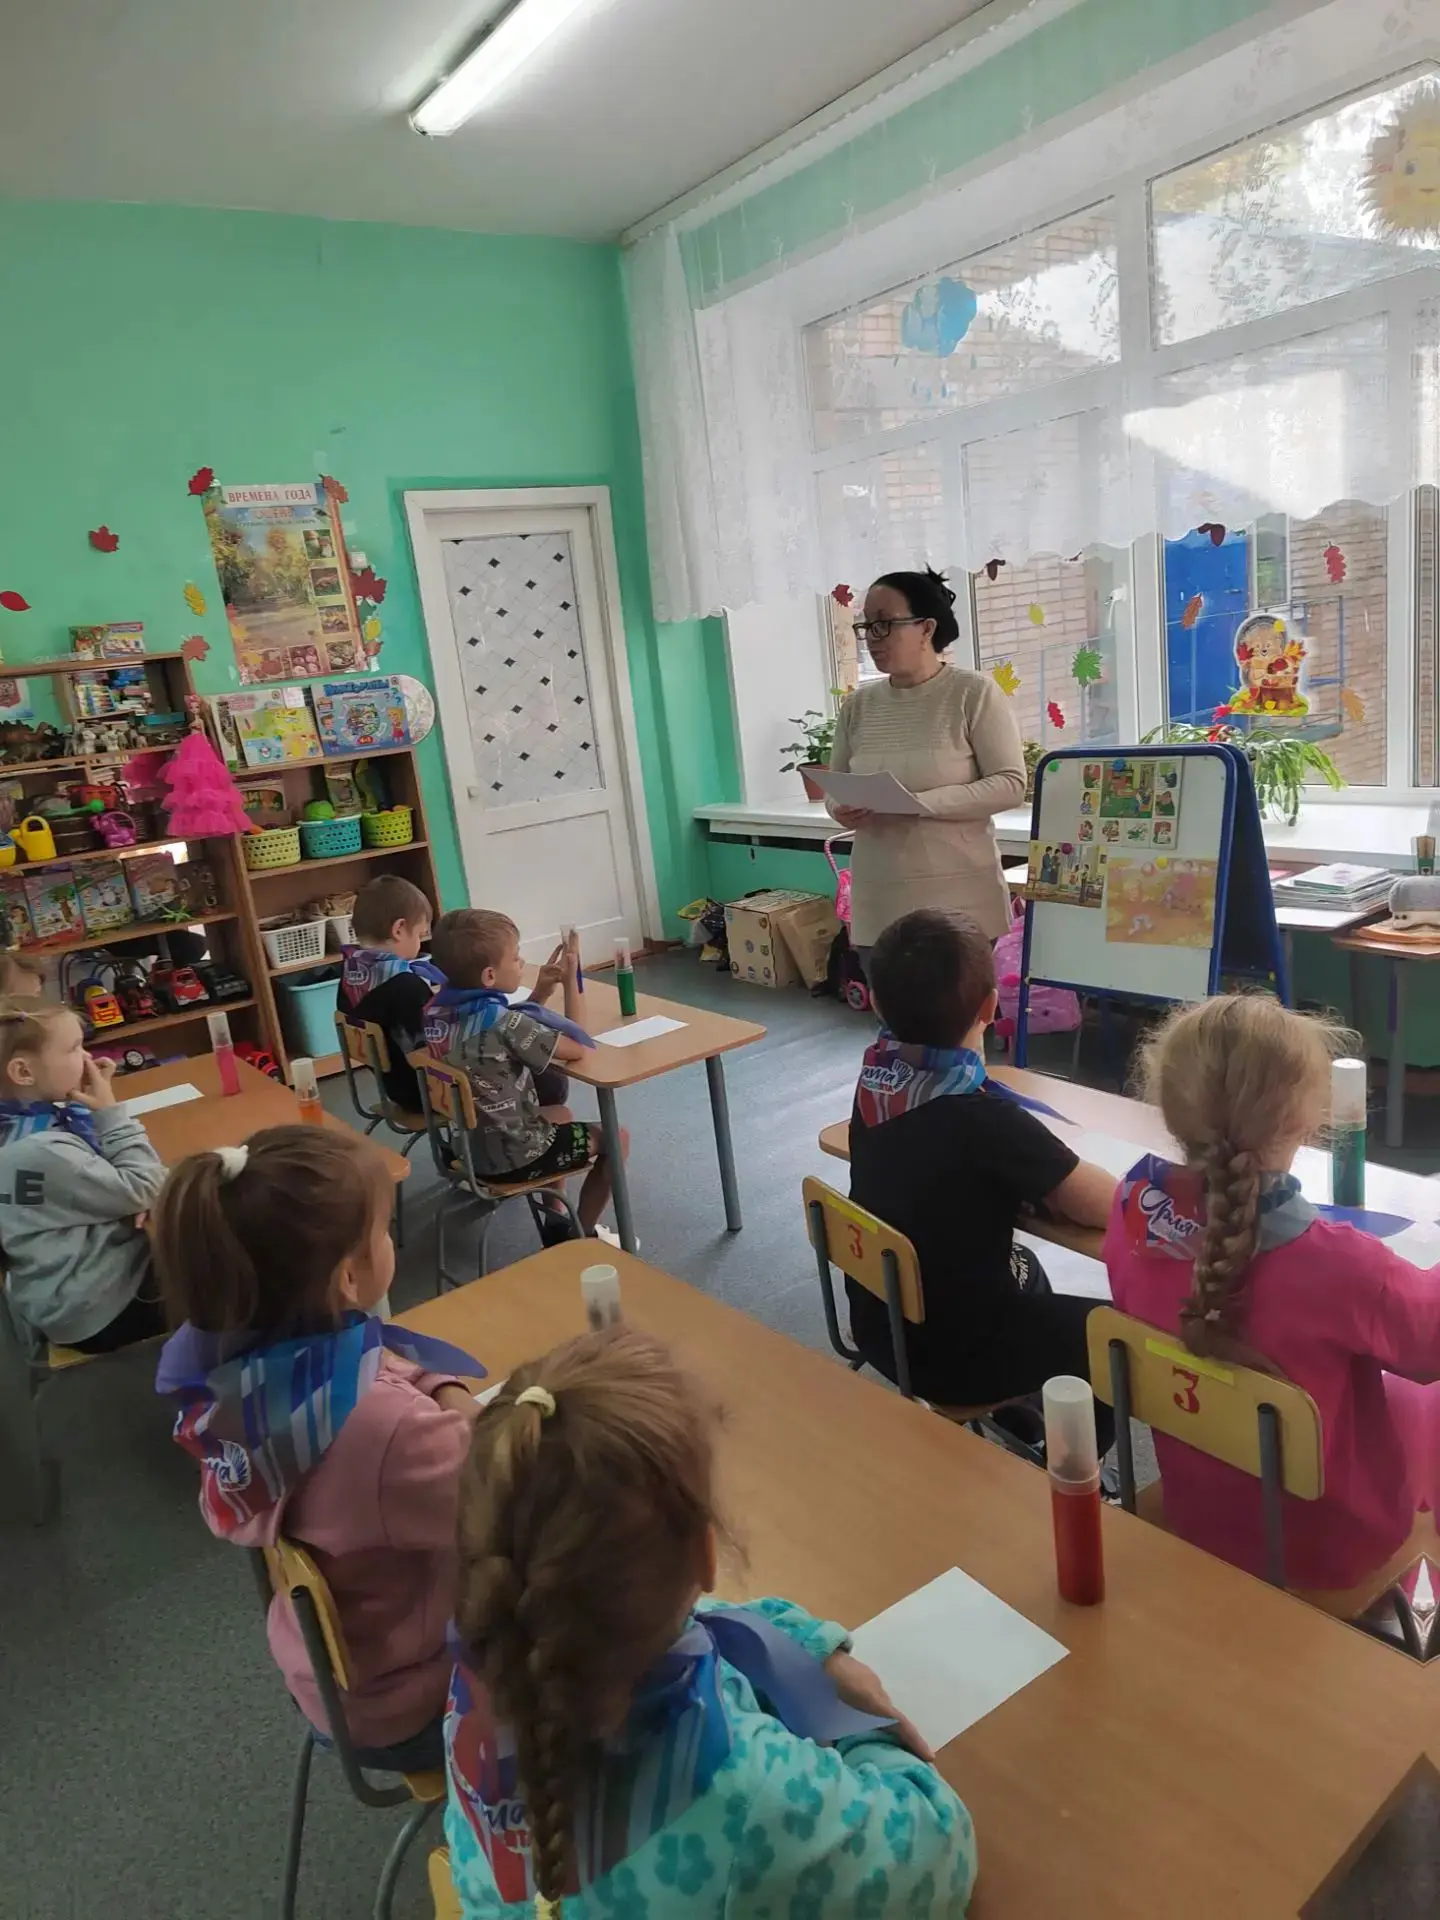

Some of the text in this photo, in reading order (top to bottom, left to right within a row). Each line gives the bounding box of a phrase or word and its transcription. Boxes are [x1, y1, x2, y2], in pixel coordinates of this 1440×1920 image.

[228, 489, 312, 502] ВРЕМЕНА ГОДА
[0, 1169, 45, 1205] E
[848, 1223, 863, 1259] 3
[1172, 1365, 1200, 1414] 3
